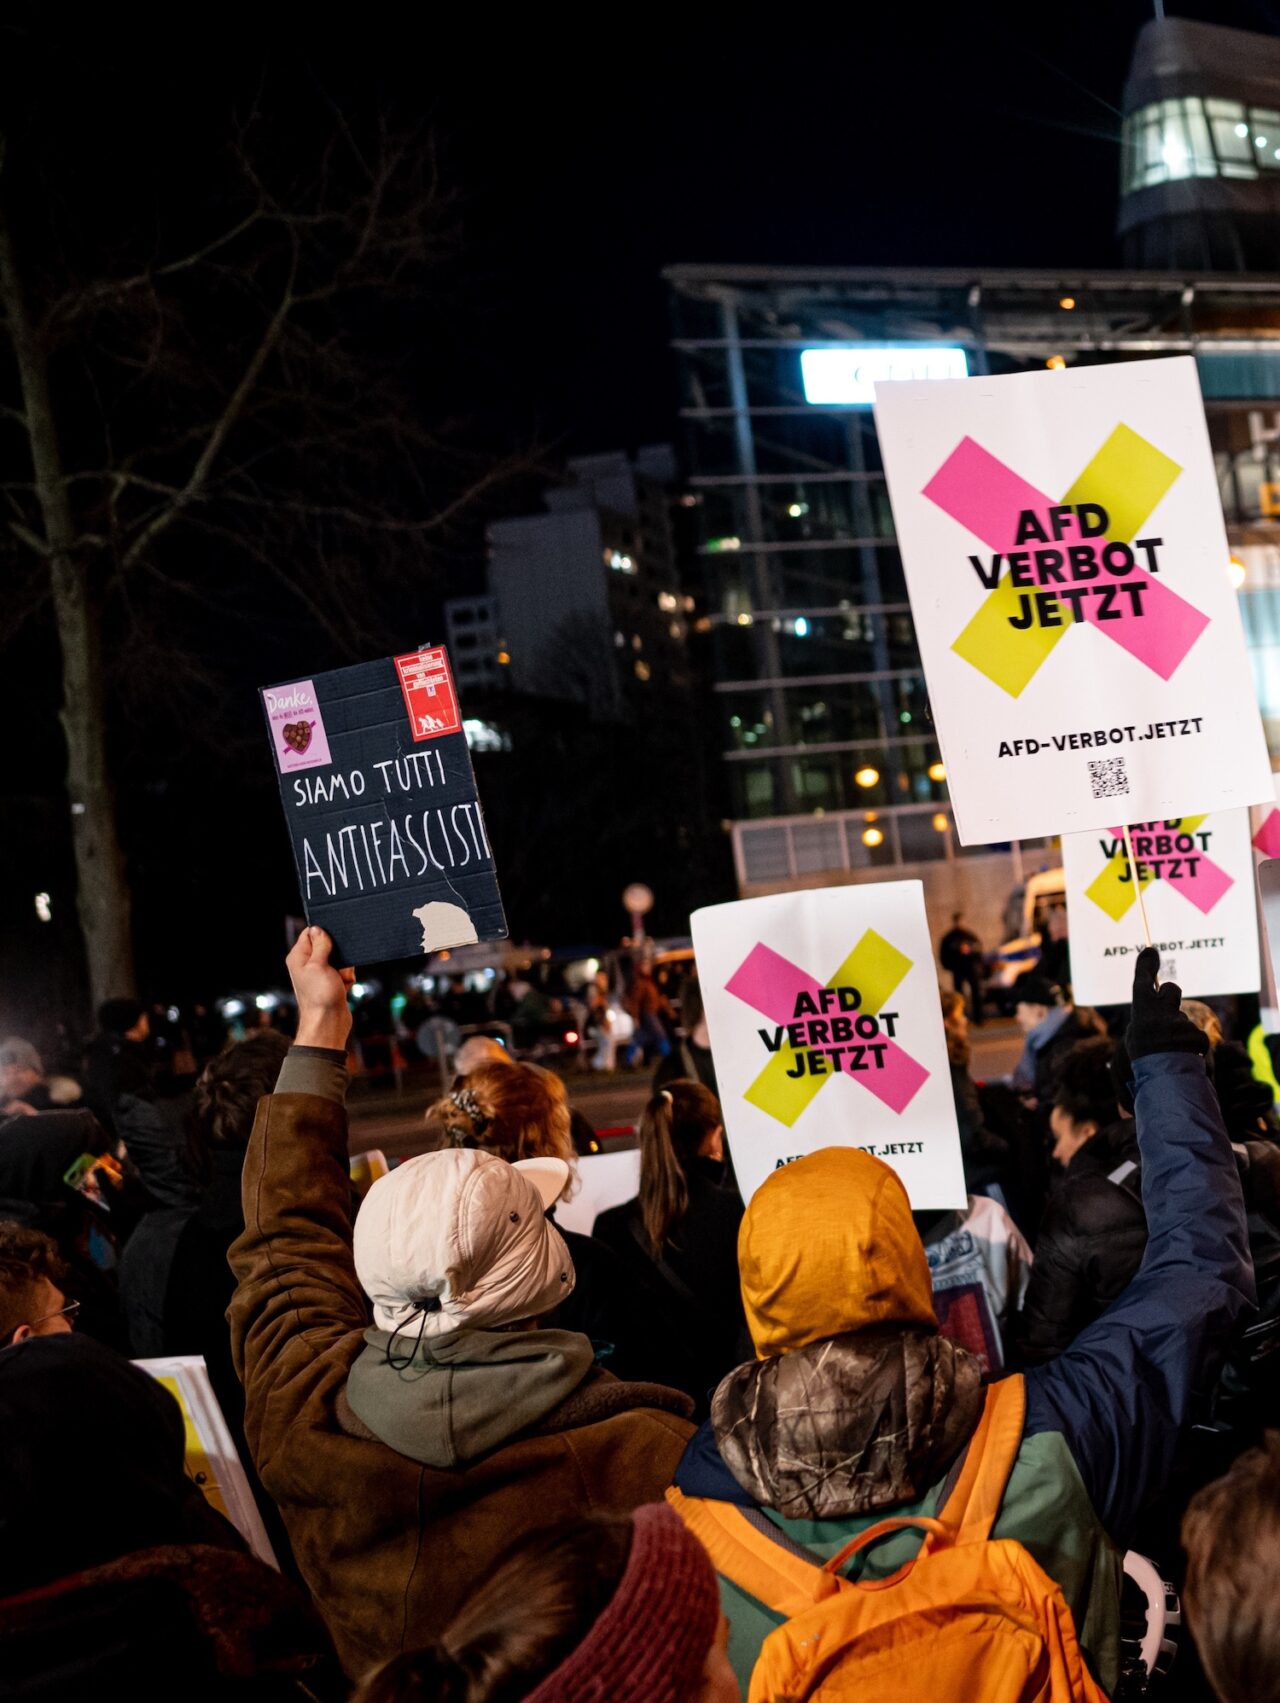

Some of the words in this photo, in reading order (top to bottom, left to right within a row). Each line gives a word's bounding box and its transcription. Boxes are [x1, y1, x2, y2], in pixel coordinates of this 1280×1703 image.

[1016, 503, 1109, 545] AFD
[969, 538, 1162, 589] VERBOT
[1008, 582, 1146, 629] JETZT
[999, 718, 1202, 757] AFD-VERBOT.JETZT
[293, 769, 366, 807] SIAMO
[373, 749, 446, 793] TUTTI
[303, 801, 491, 900] ANTIFASCISTI
[1118, 857, 1201, 882] JETZT
[793, 987, 861, 1017] AFD
[758, 1013, 899, 1052] VERBOT
[786, 1044, 887, 1078] JETZT
